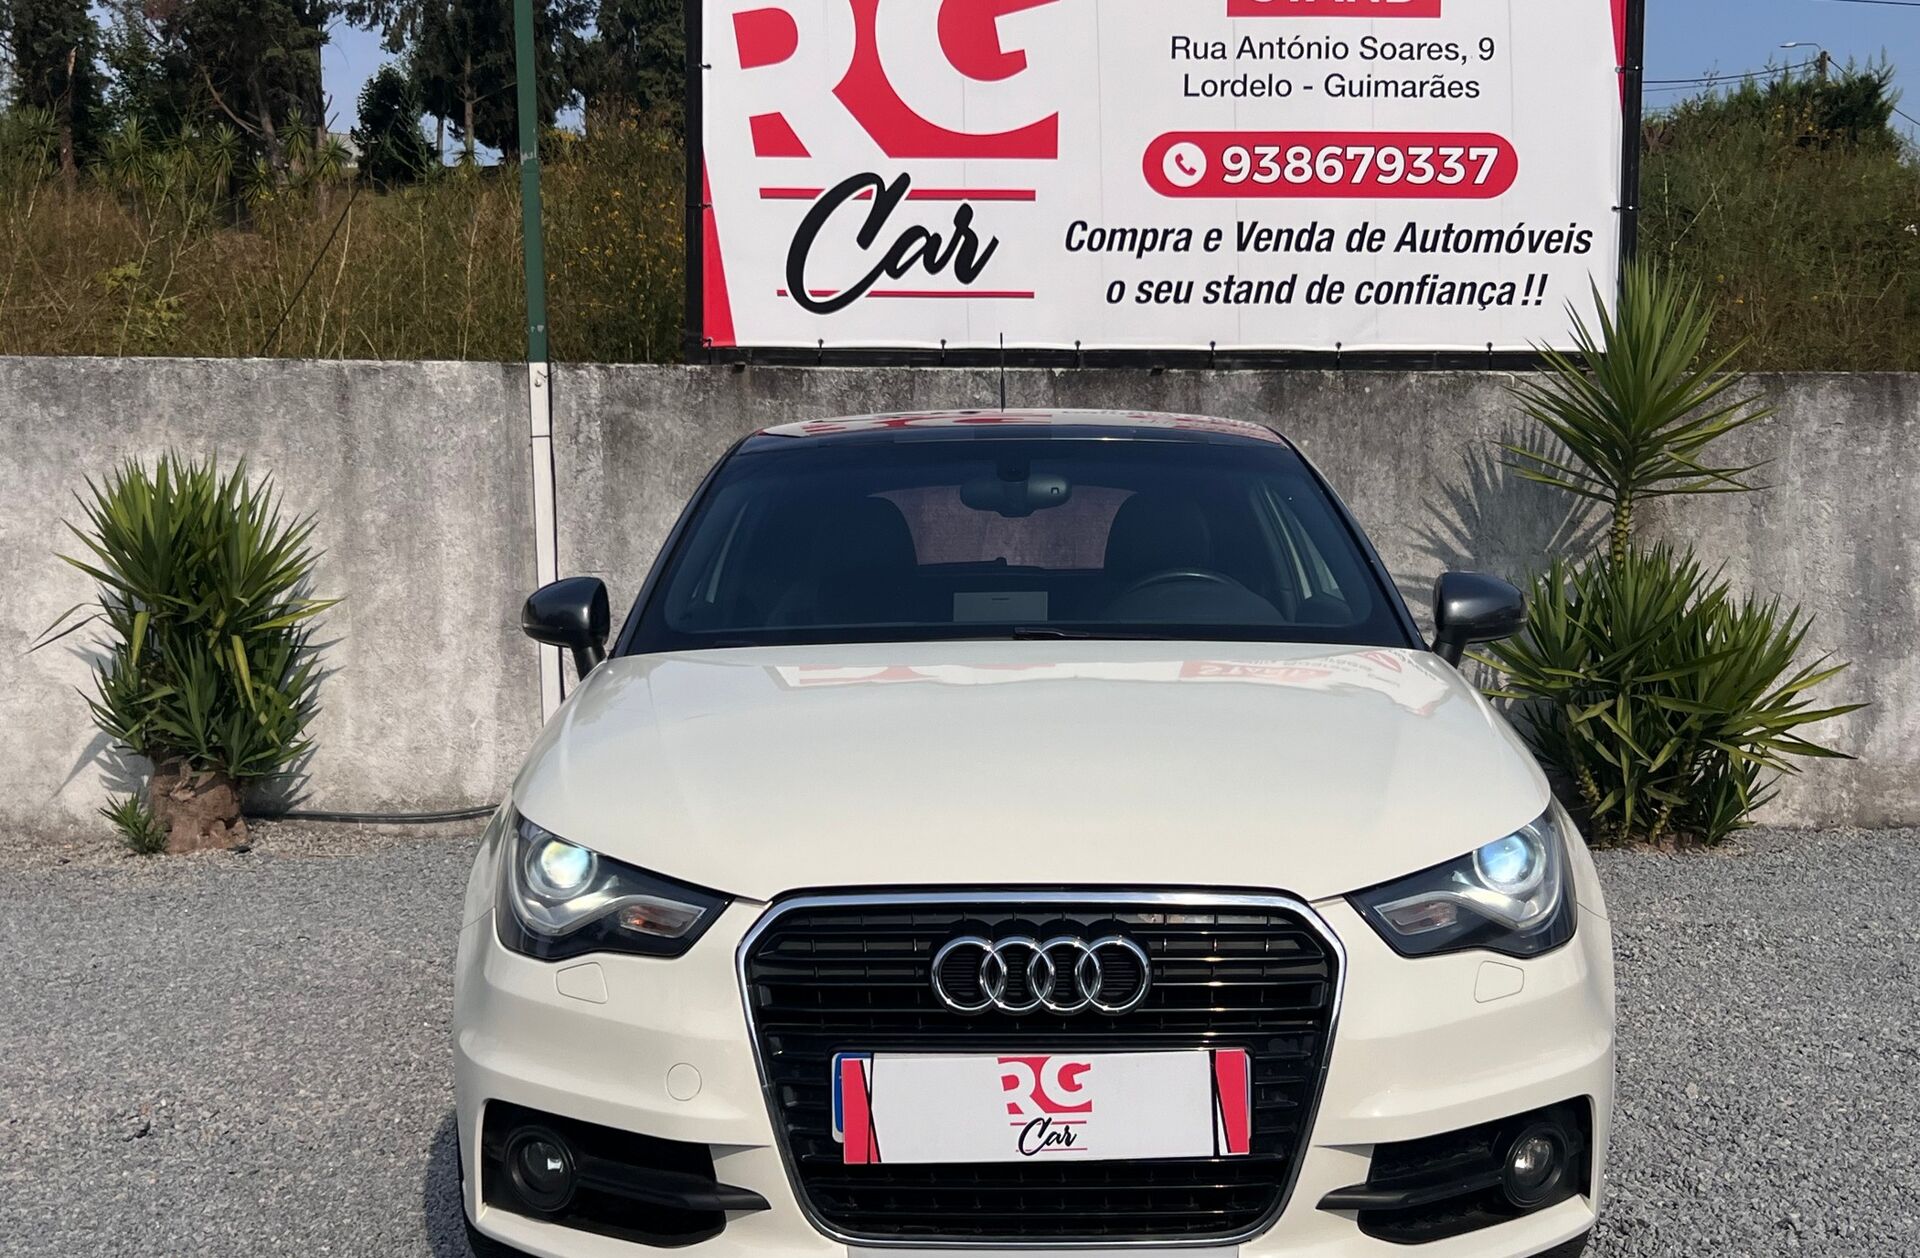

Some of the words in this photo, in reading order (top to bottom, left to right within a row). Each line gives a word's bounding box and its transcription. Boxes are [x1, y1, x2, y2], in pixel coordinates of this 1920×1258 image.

[1171, 35, 1228, 60] Rua
[1236, 35, 1349, 60] António
[1359, 35, 1467, 65] Soares,
[1478, 37, 1495, 61] 9
[1183, 73, 1292, 98] Lordelo
[1324, 73, 1480, 99] Guimarães
[1220, 145, 1499, 185] 938679337
[785, 171, 999, 315] Car
[1065, 220, 1193, 259] Compra
[1203, 228, 1223, 253] e
[1236, 221, 1335, 253] Venda
[1345, 221, 1386, 253] de
[1393, 221, 1593, 254] Automóveis
[1106, 280, 1126, 304] o
[1135, 280, 1194, 304] seu
[1202, 273, 1298, 305] stand
[1305, 273, 1345, 305] de
[997, 1055, 1093, 1115] RG
[1017, 1116, 1078, 1157] Car
